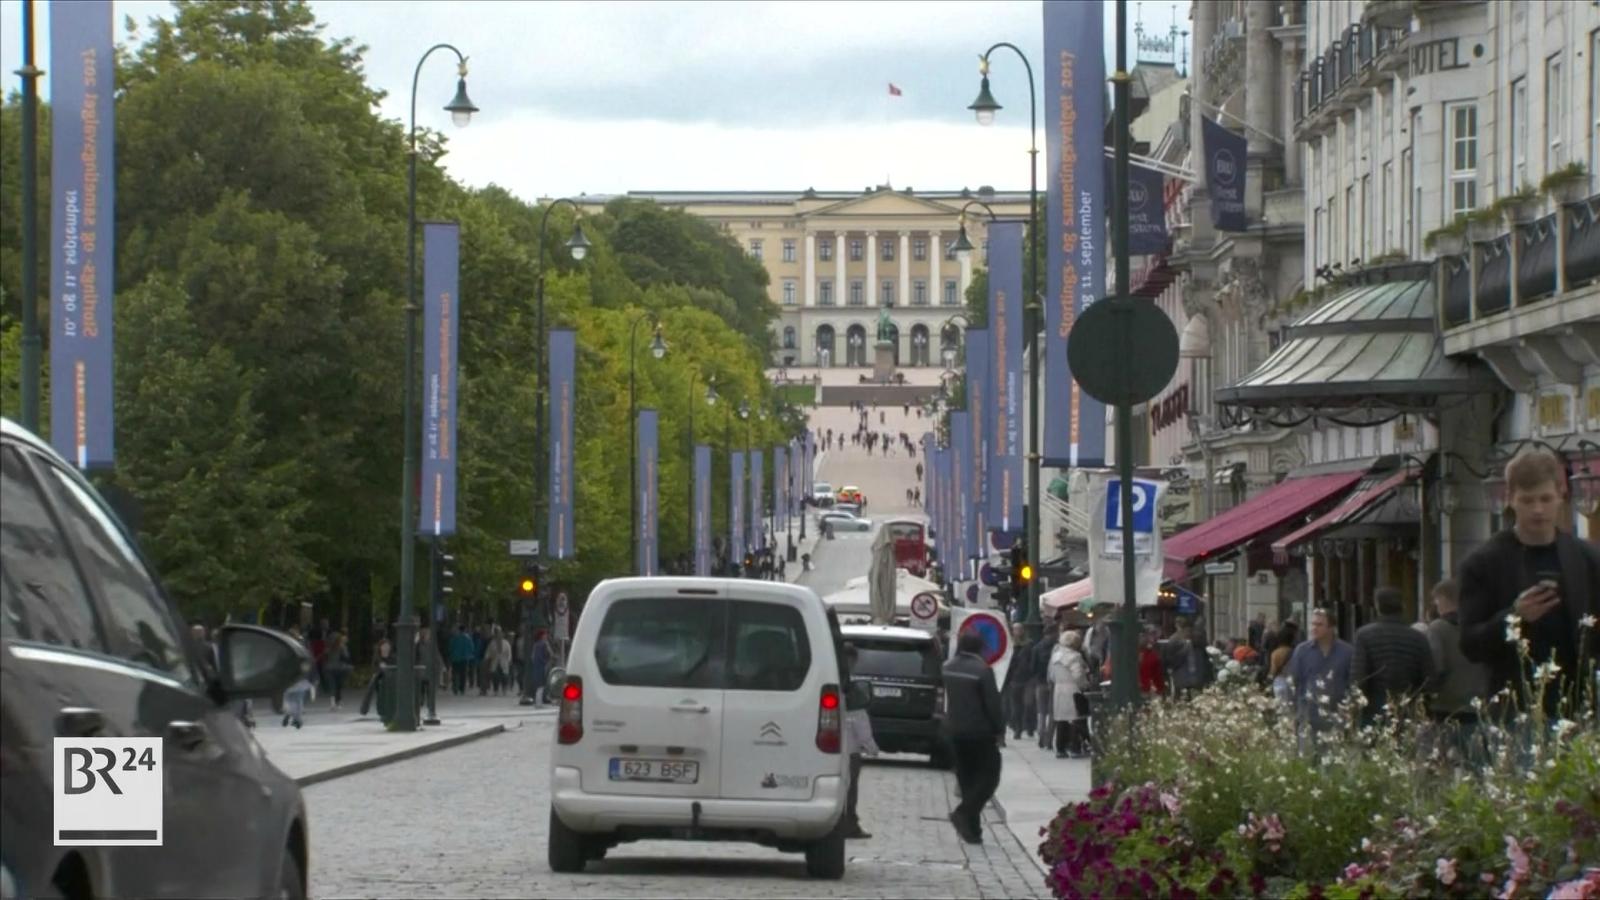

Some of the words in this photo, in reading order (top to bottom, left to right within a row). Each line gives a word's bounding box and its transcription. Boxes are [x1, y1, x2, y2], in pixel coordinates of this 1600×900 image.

[1060, 49, 1076, 88] 2017
[1409, 37, 1470, 76] HOTEL
[1063, 232, 1078, 253] og
[1079, 190, 1095, 266] september
[1081, 271, 1092, 289] 11.
[624, 762, 651, 776] 623
[661, 762, 693, 778] BSF
